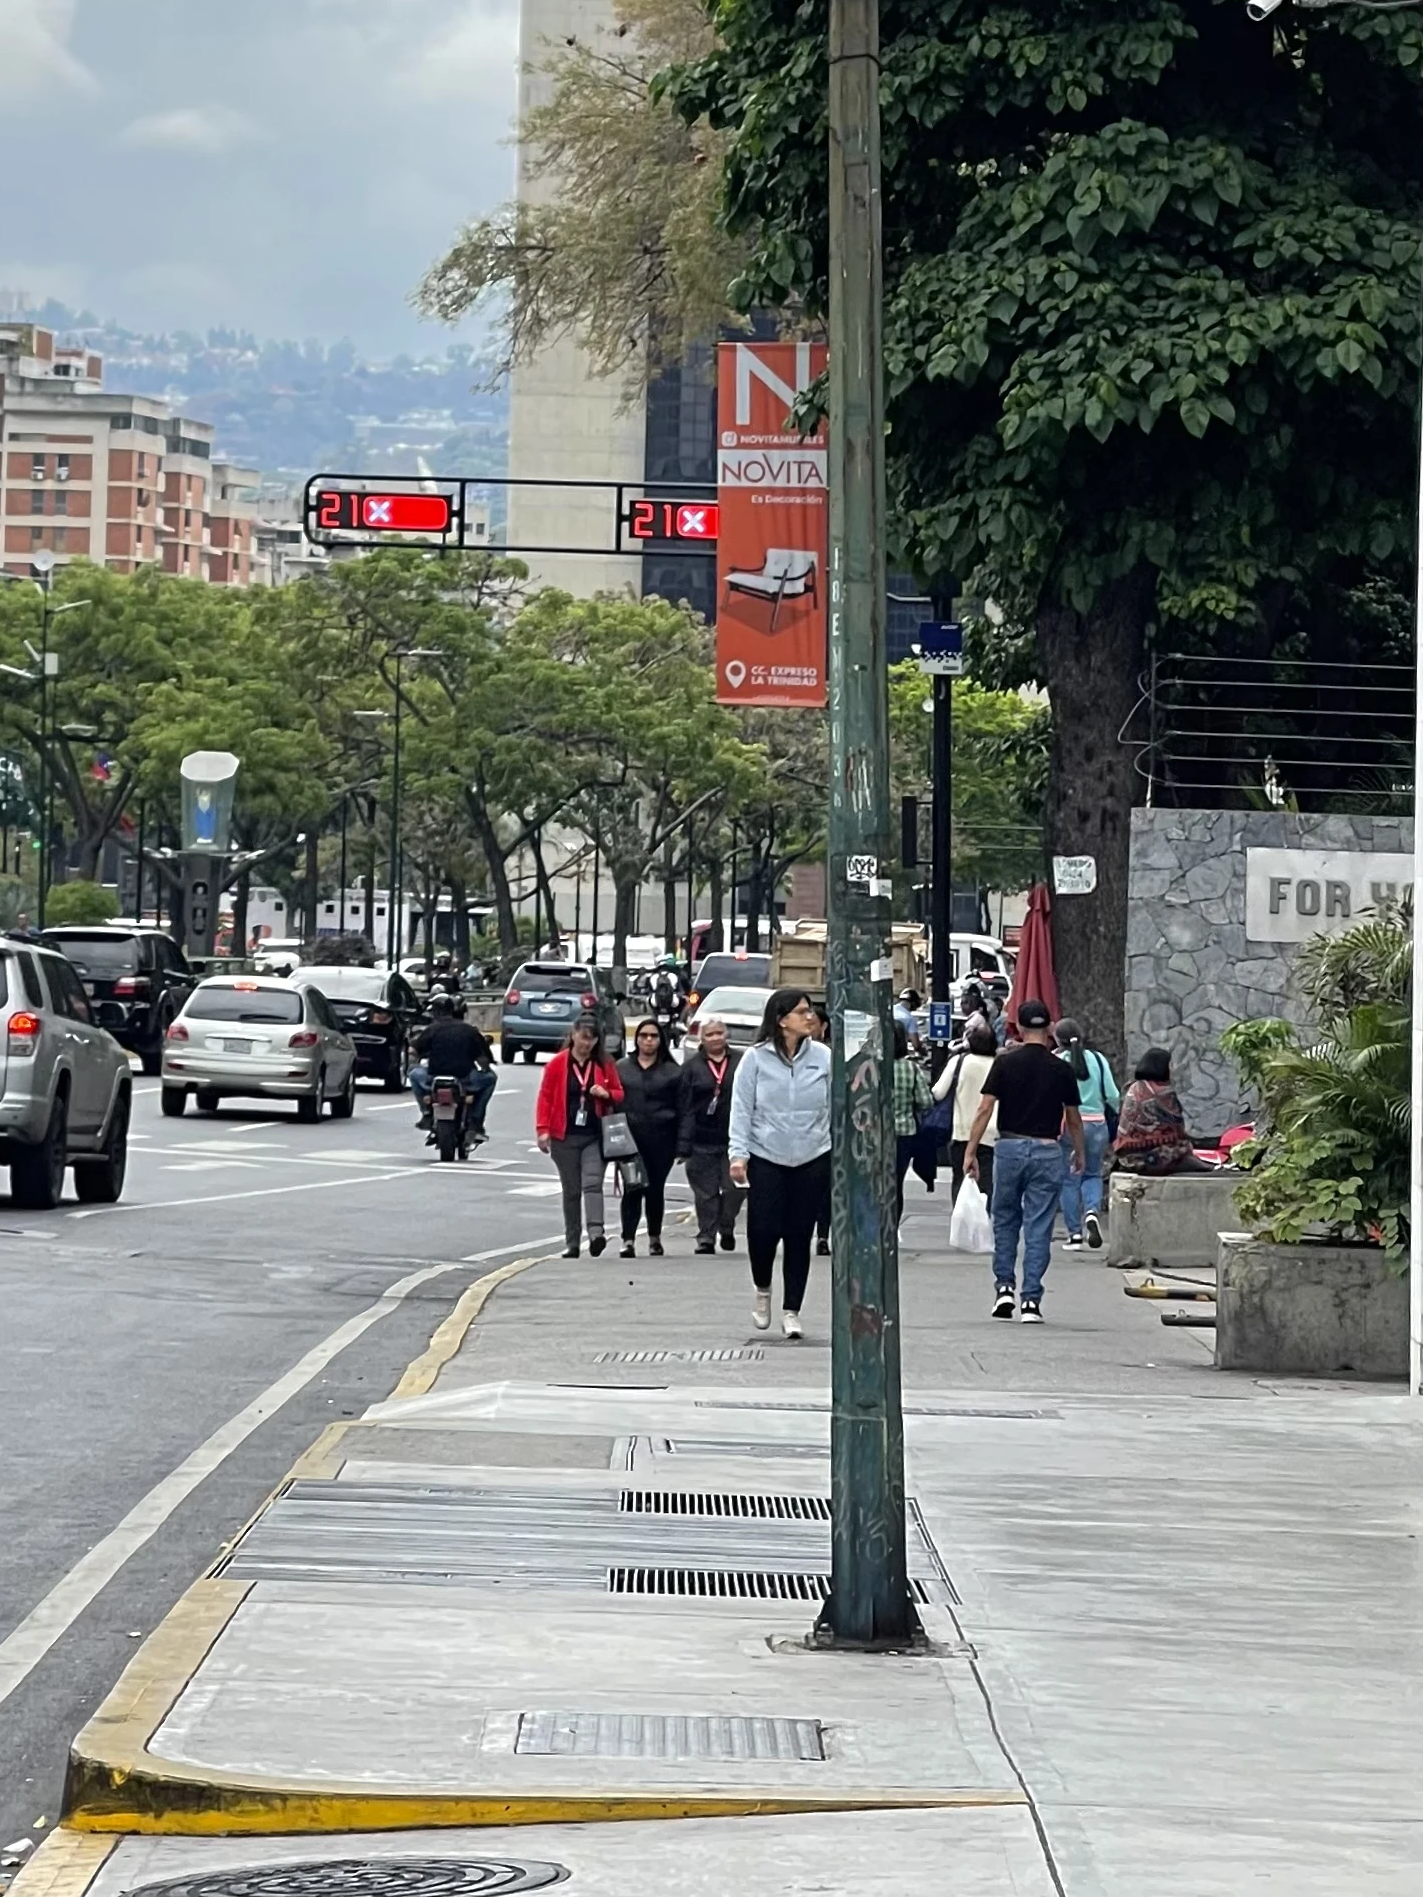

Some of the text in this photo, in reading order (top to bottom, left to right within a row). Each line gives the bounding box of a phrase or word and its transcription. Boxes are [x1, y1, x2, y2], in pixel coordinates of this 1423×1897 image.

[721, 453, 824, 485] NOVITA
[320, 493, 359, 528] 21
[633, 502, 673, 538] 21
[751, 676, 817, 686] LA TRINIDAD
[771, 666, 817, 676] EXPRESO
[1268, 876, 1351, 918] FOR
